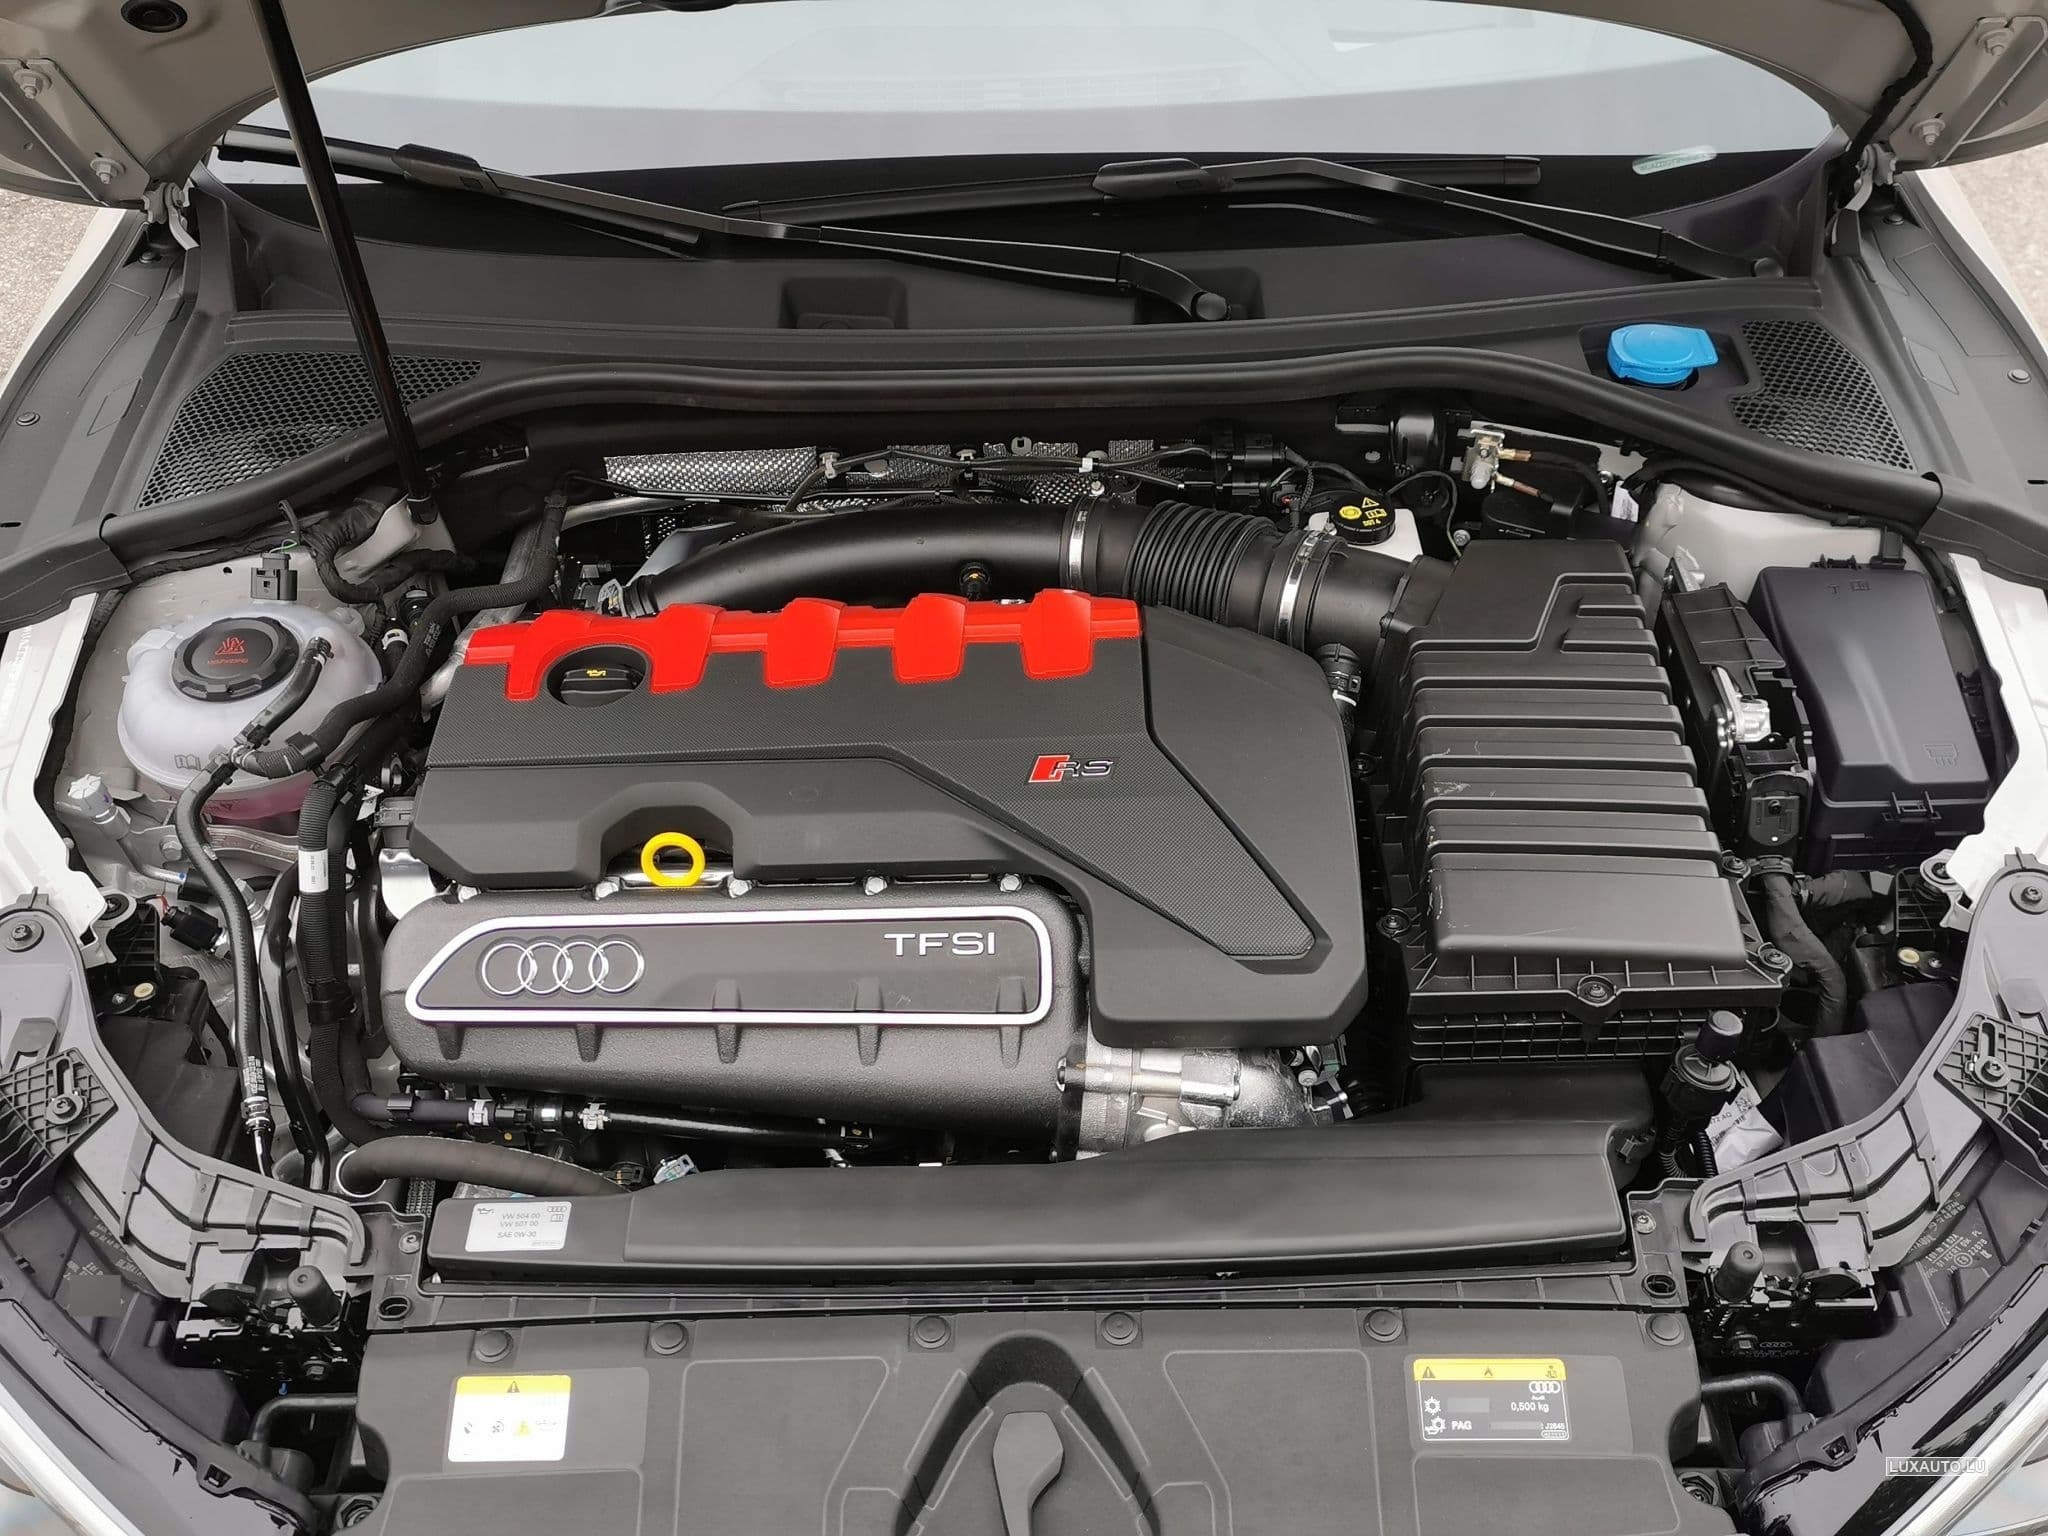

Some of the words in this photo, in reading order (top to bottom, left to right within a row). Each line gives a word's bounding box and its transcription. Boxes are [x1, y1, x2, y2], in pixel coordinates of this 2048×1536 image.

[1047, 759, 1114, 778] RS
[883, 931, 996, 957] TFSI
[502, 1212, 514, 1220] VW
[500, 1220, 514, 1228] VW
[1510, 1401, 1537, 1413] 0,500
[1537, 1401, 1550, 1414] kg
[1451, 1420, 1473, 1431] PAG
